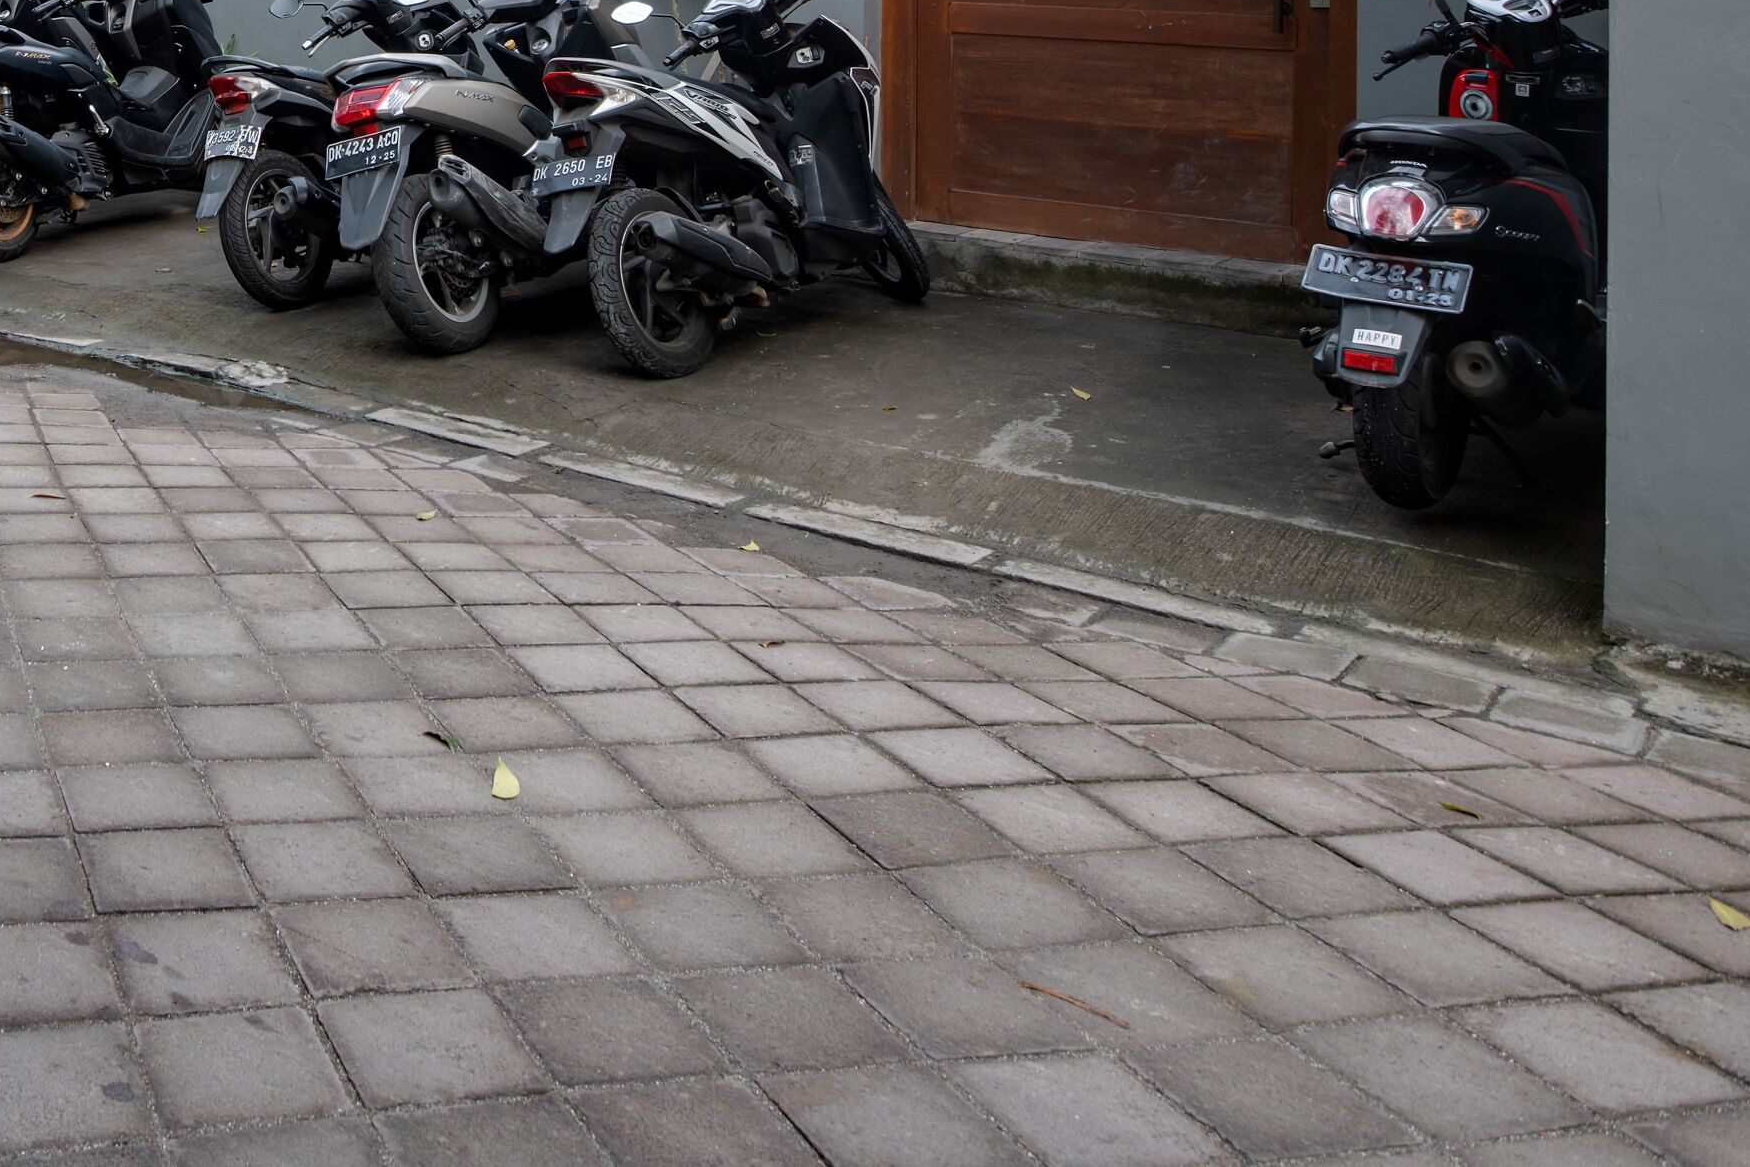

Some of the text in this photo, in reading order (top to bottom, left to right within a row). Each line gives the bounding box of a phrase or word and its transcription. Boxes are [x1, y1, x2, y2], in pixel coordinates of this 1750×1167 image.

[454, 89, 495, 103] NMAX
[329, 144, 342, 163] DK
[345, 138, 374, 157] 4243
[532, 154, 613, 182] DK 2650 EB
[1390, 160, 1428, 168] HONDA
[1318, 252, 1353, 276] DK
[1357, 259, 1423, 287] 2284
[1357, 331, 1396, 346] HAPPY
